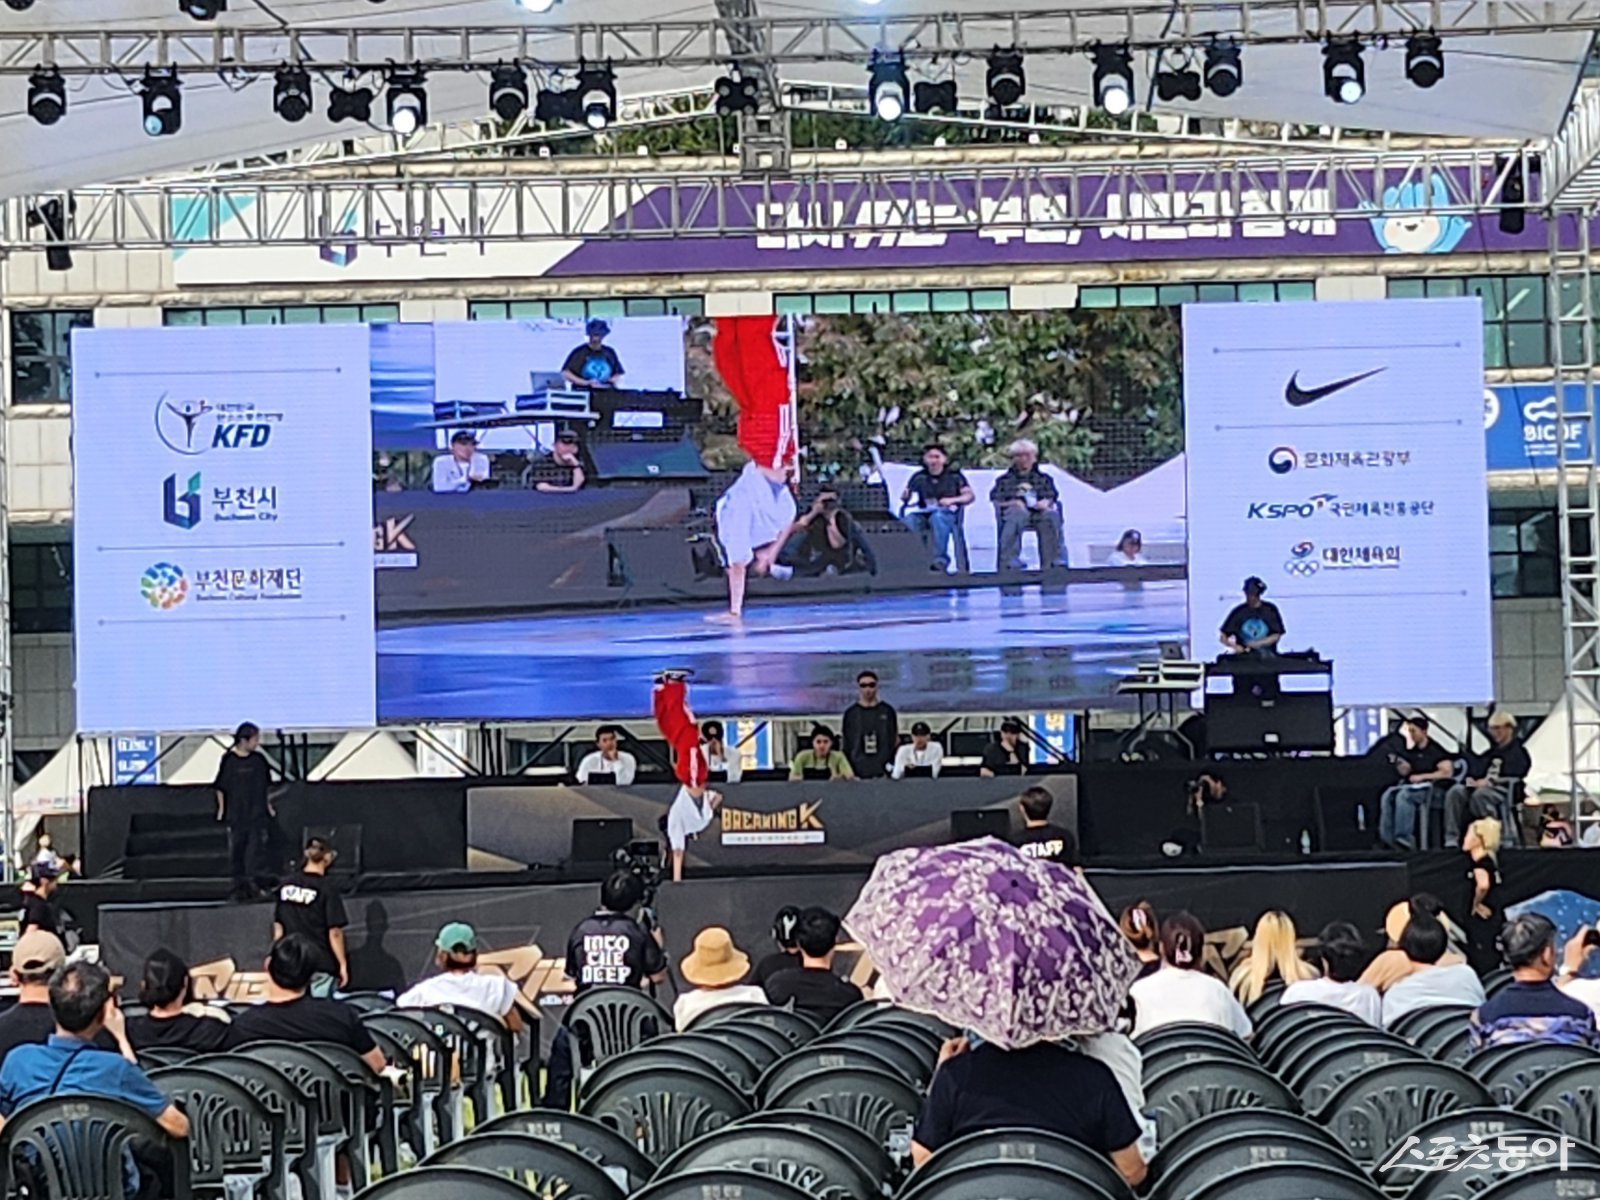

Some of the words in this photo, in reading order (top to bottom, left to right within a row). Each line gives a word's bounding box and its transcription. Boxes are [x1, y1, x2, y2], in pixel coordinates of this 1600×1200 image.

[212, 424, 271, 448] KFD
[212, 486, 276, 510] 부천시
[1247, 503, 1314, 519] KSPO
[195, 568, 302, 591] 부천문화재단
